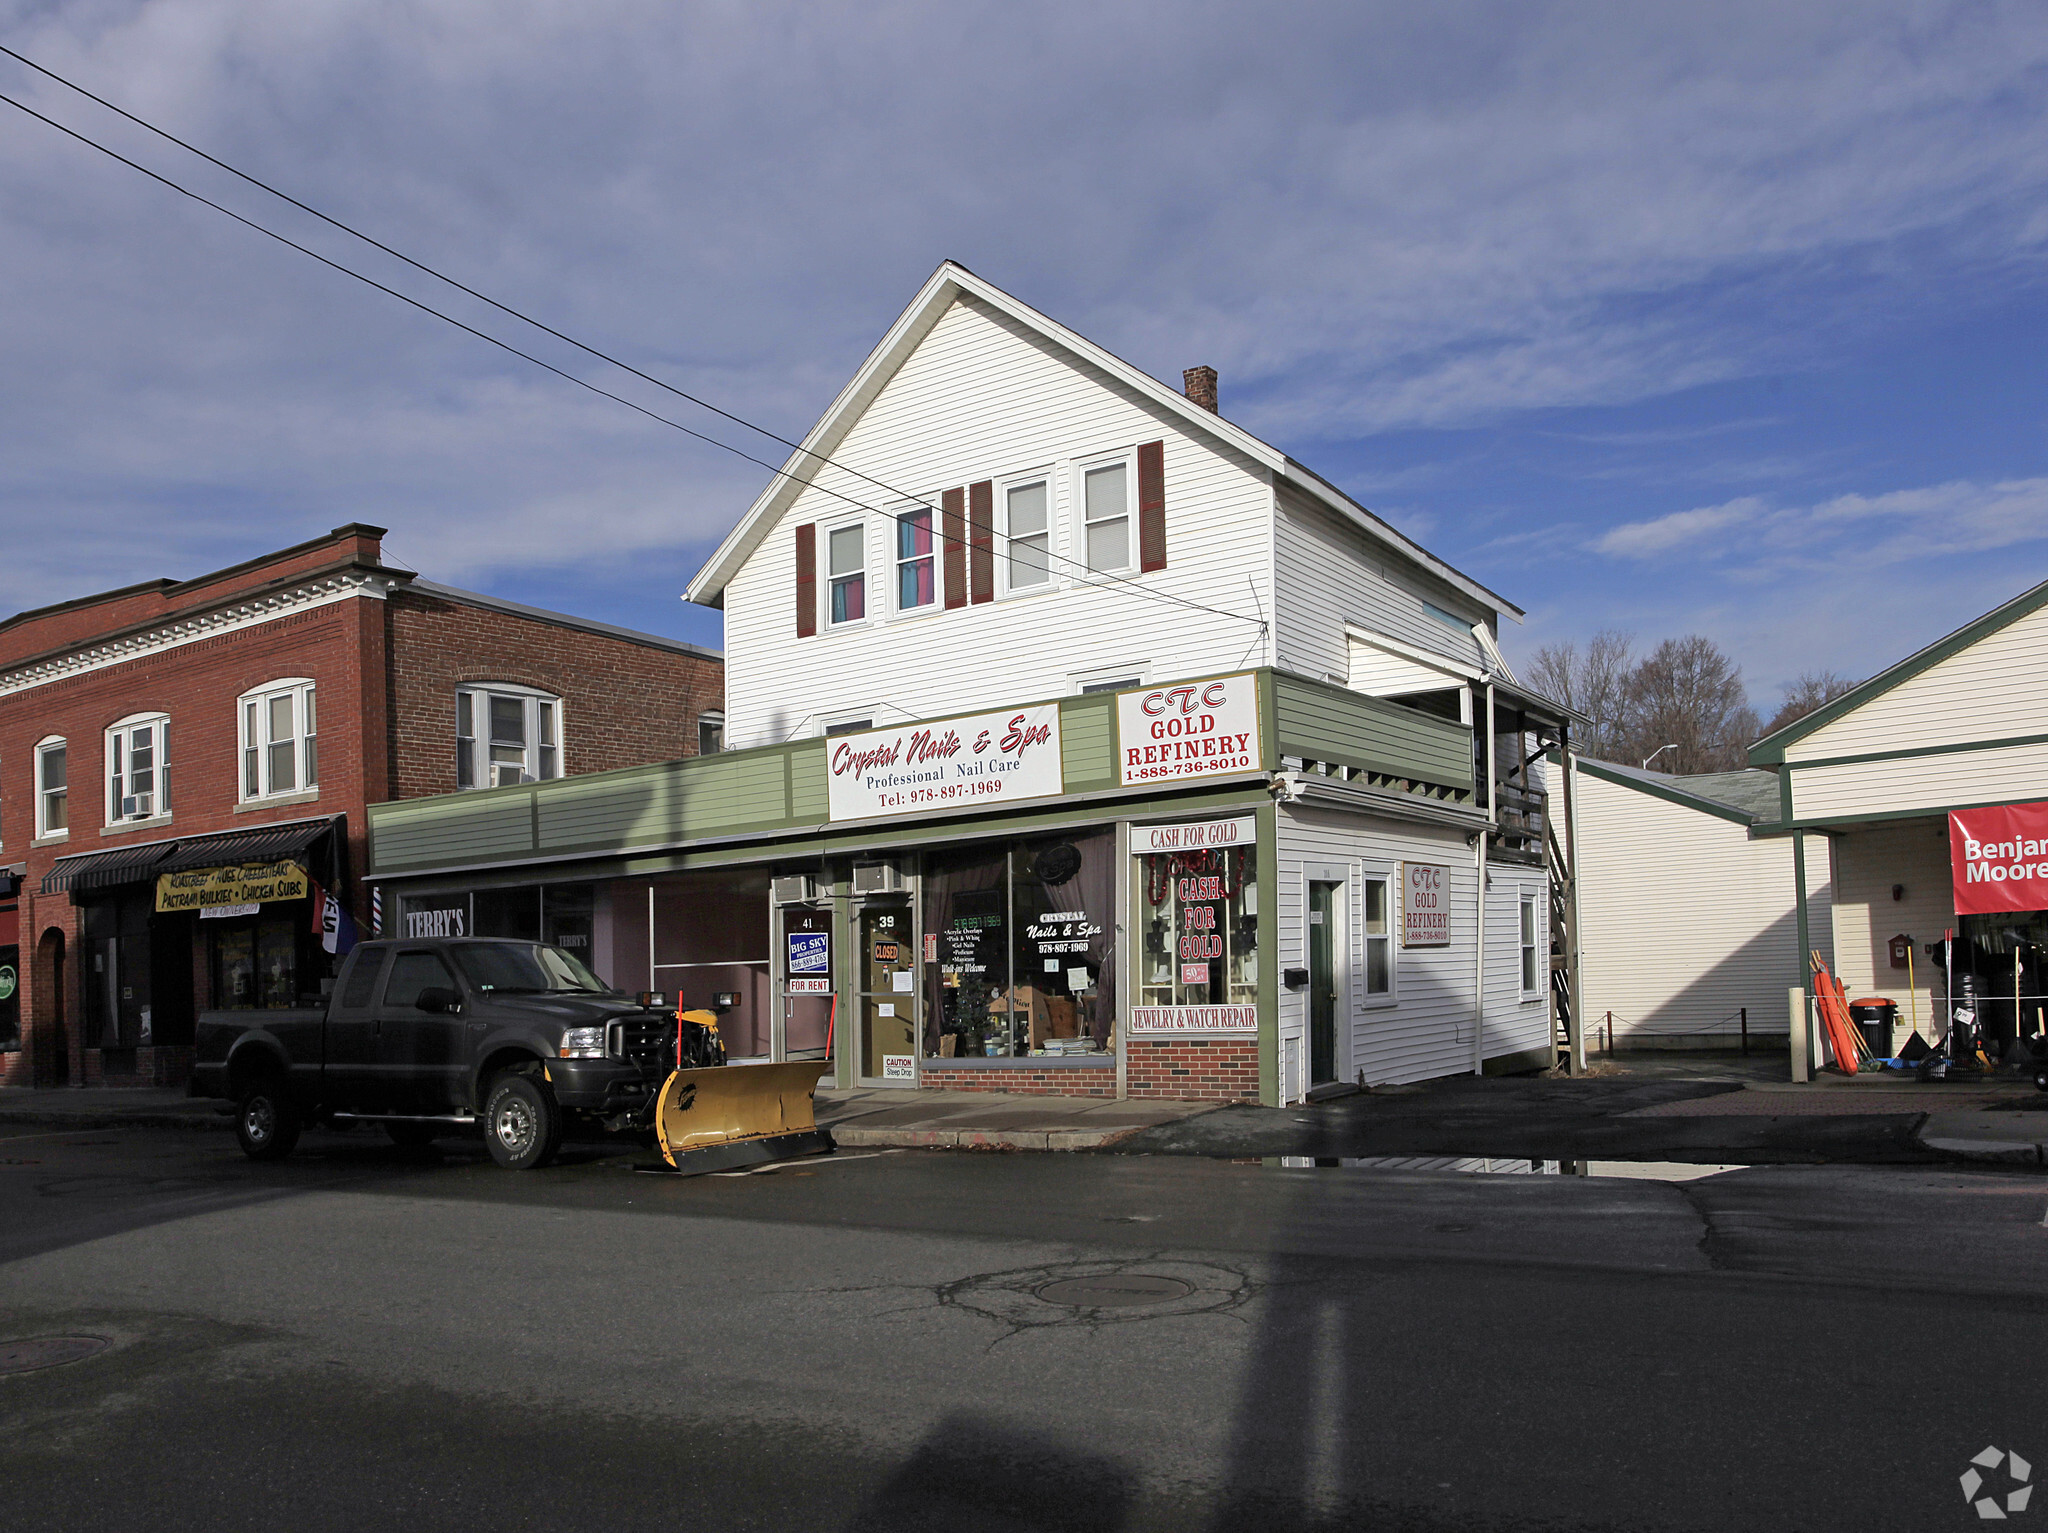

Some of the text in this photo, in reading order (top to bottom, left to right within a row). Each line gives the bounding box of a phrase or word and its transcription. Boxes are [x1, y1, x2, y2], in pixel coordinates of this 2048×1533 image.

[1141, 682, 1226, 717] CTC
[1151, 715, 1215, 739] GOLD
[832, 714, 1051, 781] Crystal Nails & Spa
[1127, 733, 1250, 766] REFINERY
[867, 759, 1020, 789] Professional Nail Care
[1127, 756, 1249, 780] 1-888-736-8010
[879, 780, 1002, 807] Tel: 978-897-1969
[1151, 823, 1237, 848] CASH FOR GOLD
[216, 869, 236, 884] HUGE
[237, 862, 288, 881] CHEESESTEAKS
[1412, 867, 1440, 891] CTC
[162, 880, 301, 908] PASTRAMI BULKIES CHICKEN SUBS
[1179, 877, 1220, 901] CASH
[1415, 892, 1437, 908] GOLD
[407, 909, 463, 938] TERRY'S
[803, 919, 812, 928] 41
[879, 916, 894, 928] 39
[1040, 911, 1087, 923] CRYSTAL
[1185, 907, 1215, 929] FOR
[1407, 913, 1447, 928] REFINERY
[559, 935, 587, 947] TERRY'S
[1026, 922, 1101, 939] Nails & Spa
[791, 936, 826, 954] BIG SKY
[876, 945, 897, 959] CLOSED
[1039, 942, 1089, 954] 978-897-1969
[1180, 935, 1222, 958] GOLD
[792, 981, 827, 990] FOR RENT
[1134, 1008, 1256, 1028] JEWELRY & WATCH REPAIR
[887, 1068, 912, 1077] Steep Drop
